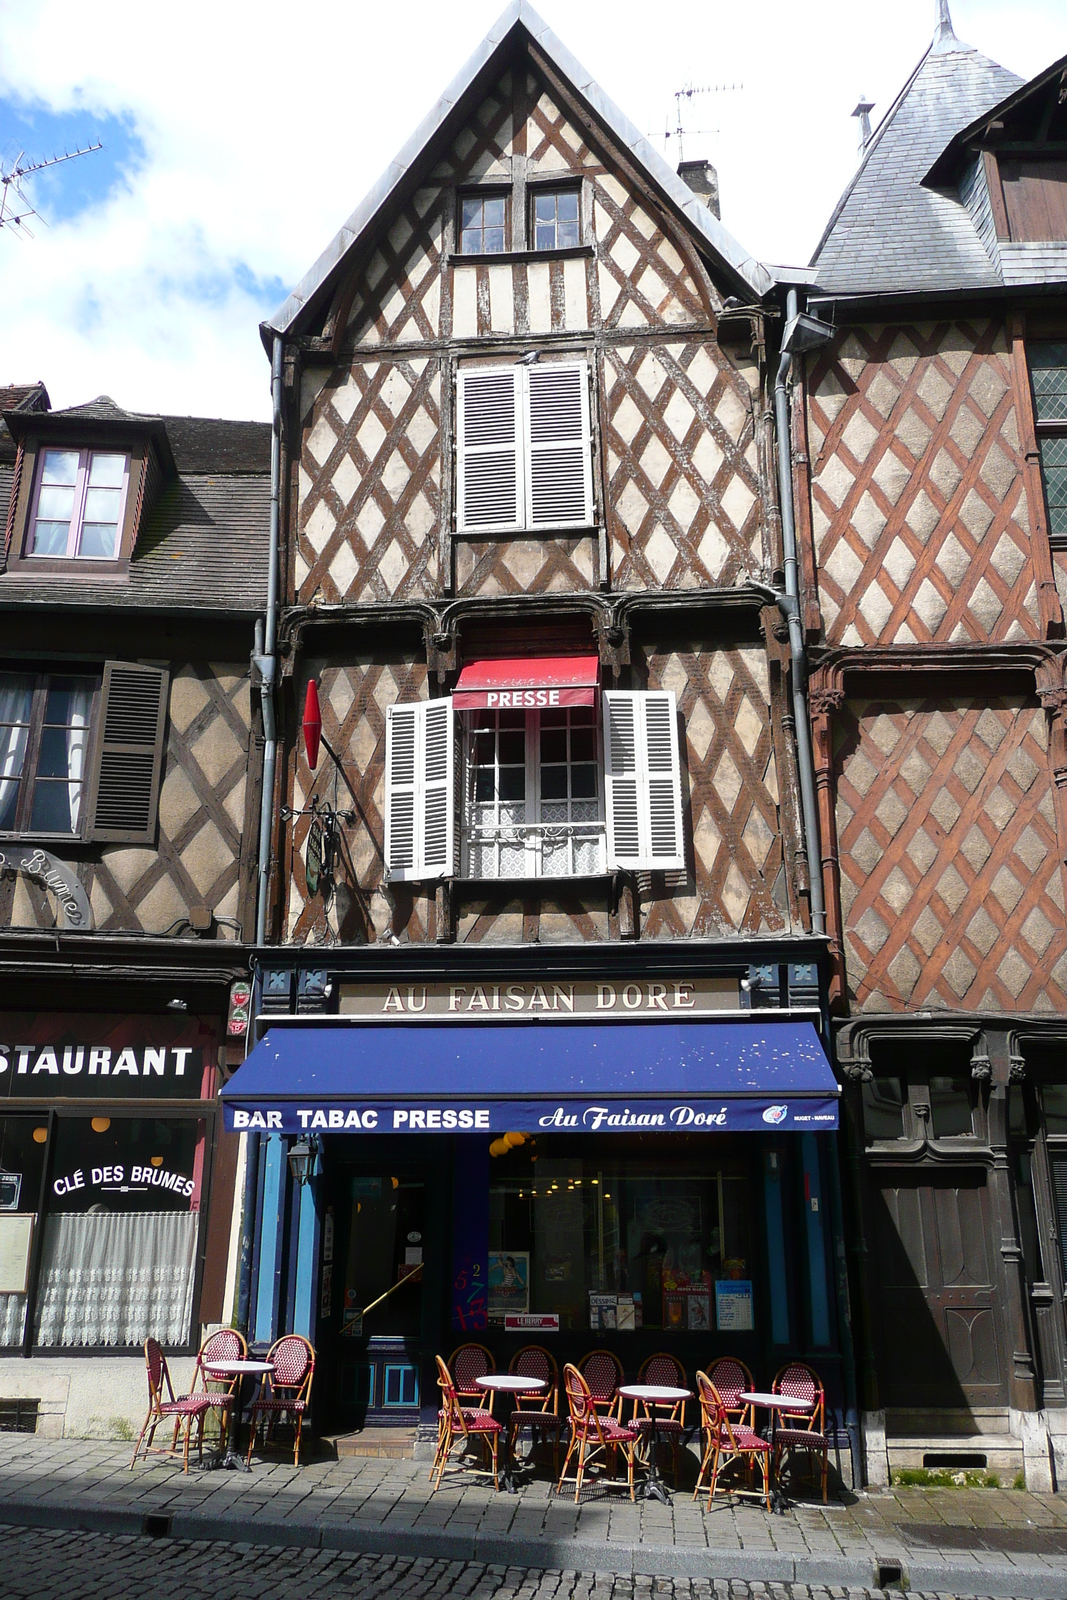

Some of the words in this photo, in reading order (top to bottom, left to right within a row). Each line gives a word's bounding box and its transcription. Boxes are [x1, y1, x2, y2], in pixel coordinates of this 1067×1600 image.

[487, 689, 560, 707] PRESSE
[381, 986, 428, 1012] AU
[448, 984, 575, 1012] FAISAN
[595, 981, 696, 1011] DORÉ
[233, 1110, 284, 1129] BAR
[297, 1110, 378, 1129] TABAC
[393, 1110, 490, 1129] PRESSE
[538, 1107, 579, 1127] Au
[583, 1106, 667, 1130] Faisan
[669, 1106, 728, 1126] Doré
[53, 1168, 86, 1196] CLÉ
[91, 1165, 125, 1185] DES
[130, 1165, 196, 1197] BRUMES
[454, 1269, 470, 1290] 5
[472, 1263, 481, 1277] 2
[517, 1317, 524, 1325] LE
